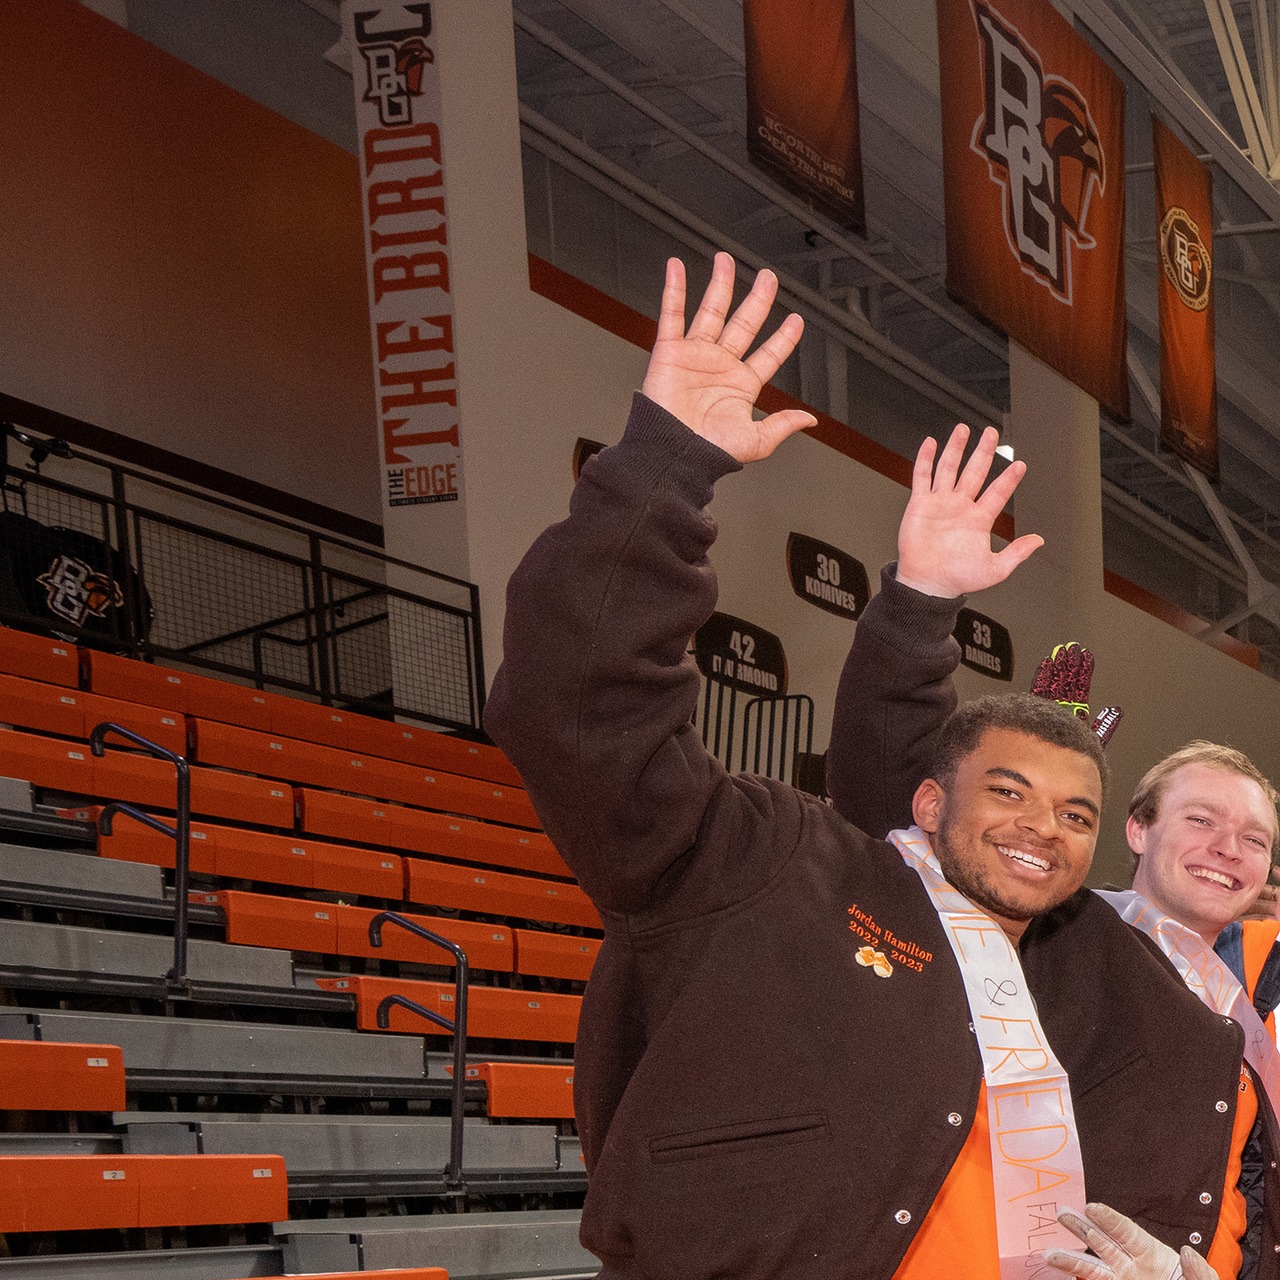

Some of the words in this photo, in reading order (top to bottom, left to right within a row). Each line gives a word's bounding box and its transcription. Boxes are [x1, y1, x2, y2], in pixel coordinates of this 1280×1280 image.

[363, 121, 450, 305] BIRD
[376, 314, 461, 465] THE
[388, 468, 404, 498] THE
[405, 463, 458, 496] EDGE
[817, 553, 840, 587] 30
[805, 574, 856, 612] KOMIVES
[729, 630, 755, 664] 42
[972, 619, 992, 648] 33
[965, 644, 1001, 672] DANIELS
[847, 904, 882, 935] Jordan
[883, 930, 933, 962] Hamilton
[848, 920, 879, 947] 2022
[891, 950, 924, 972] 2023
[984, 978, 1018, 1005] &
[980, 1013, 1070, 1203] FRIEDA
